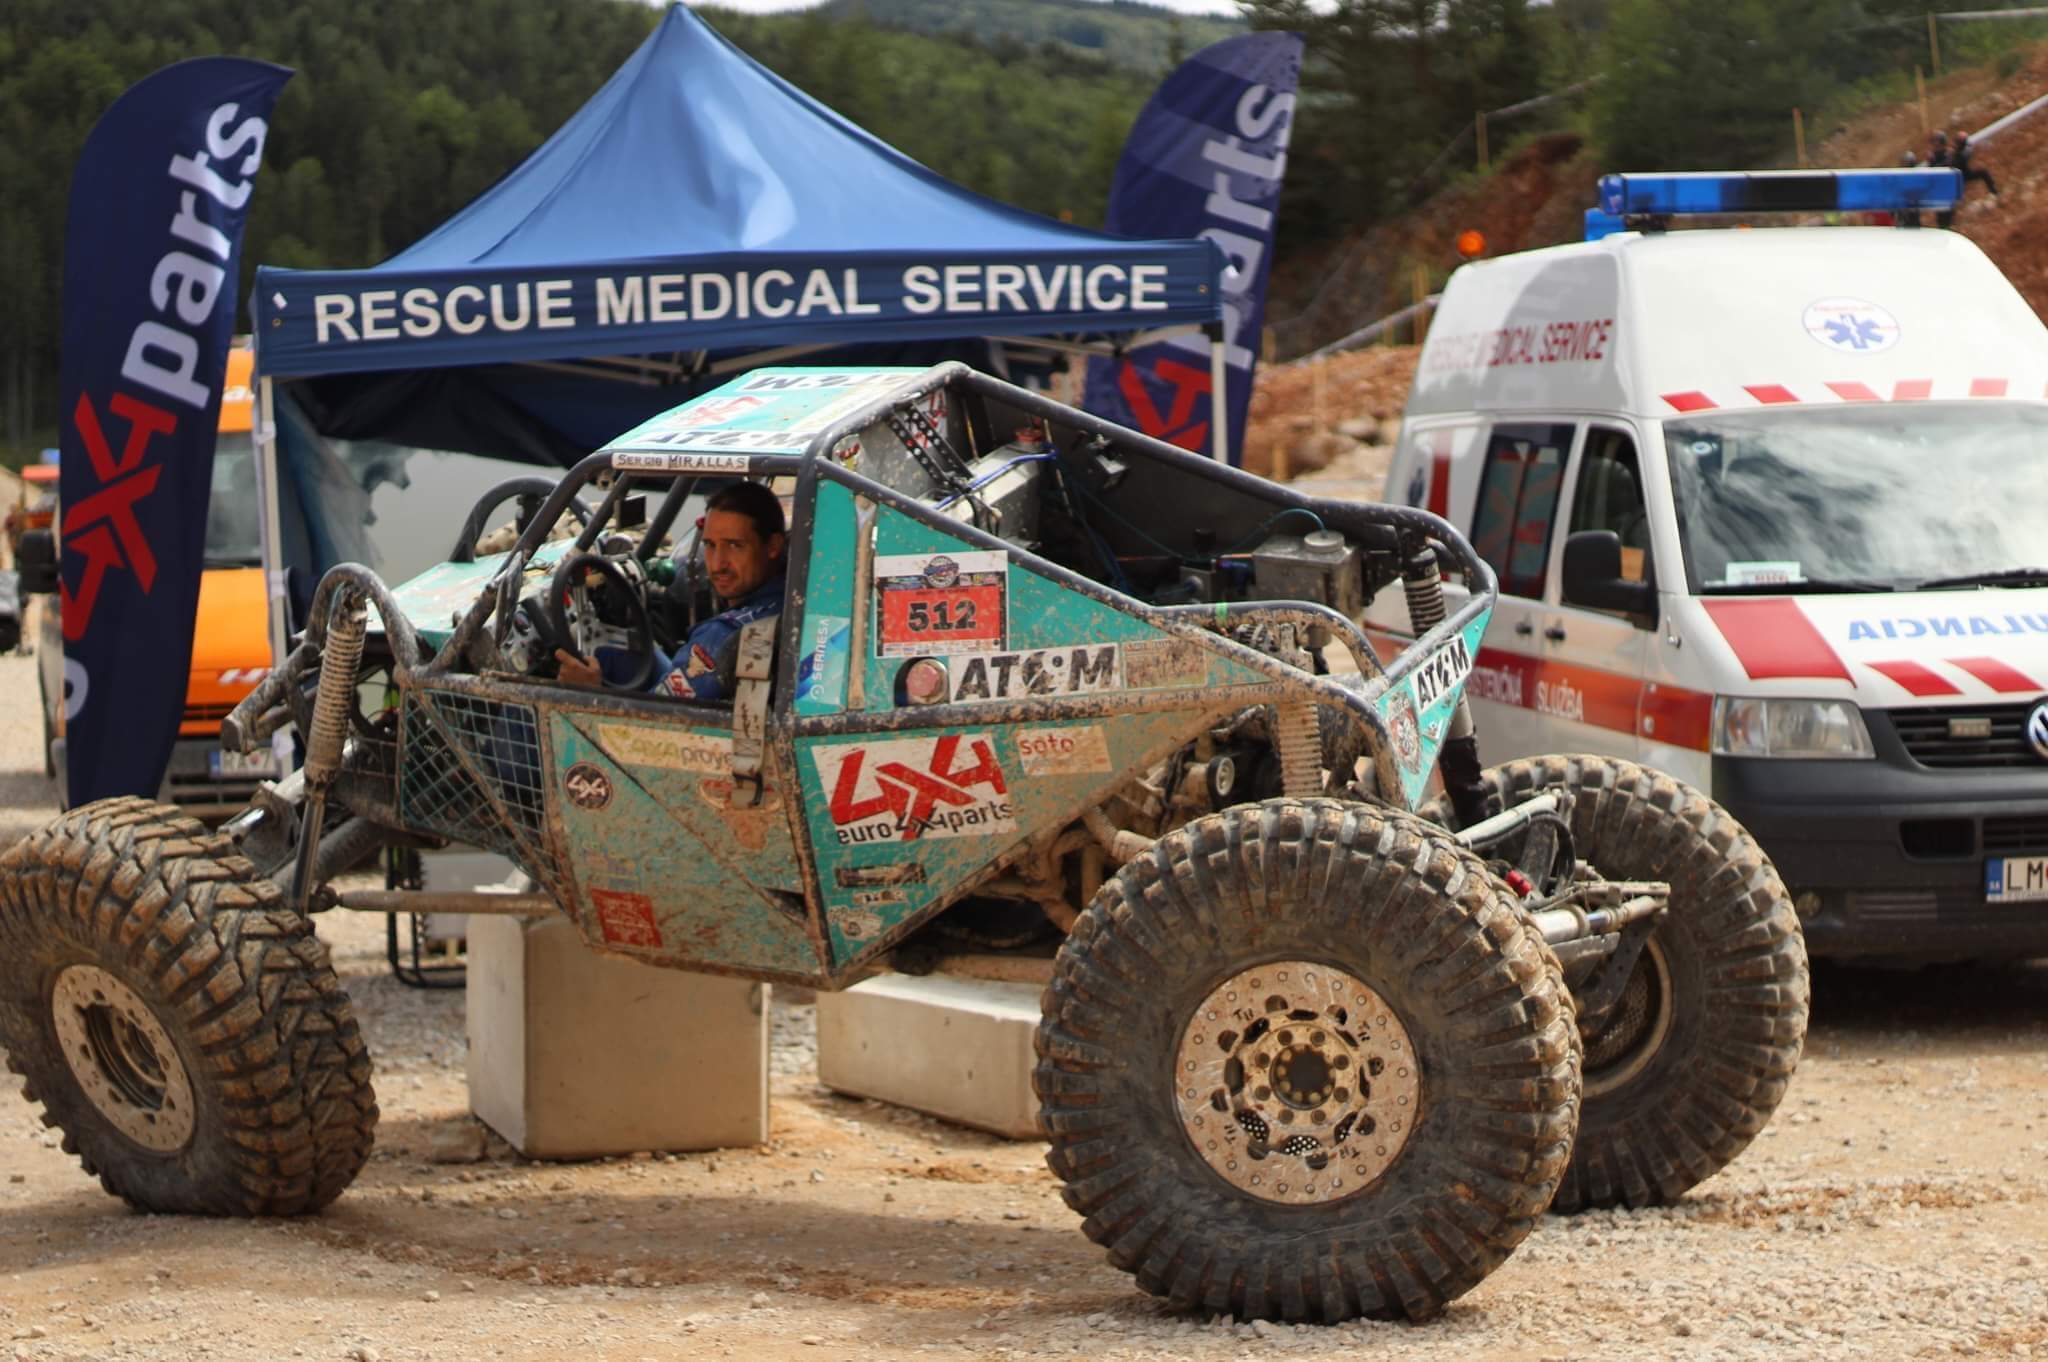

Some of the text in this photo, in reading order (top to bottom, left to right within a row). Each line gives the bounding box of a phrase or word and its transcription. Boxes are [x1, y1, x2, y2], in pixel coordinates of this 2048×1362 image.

[314, 265, 1169, 343] RESCUE MEDICAL SERVICE
[1539, 319, 1613, 363] SERVICE
[668, 454, 747, 469] MIRALLAS
[907, 599, 977, 632] 512
